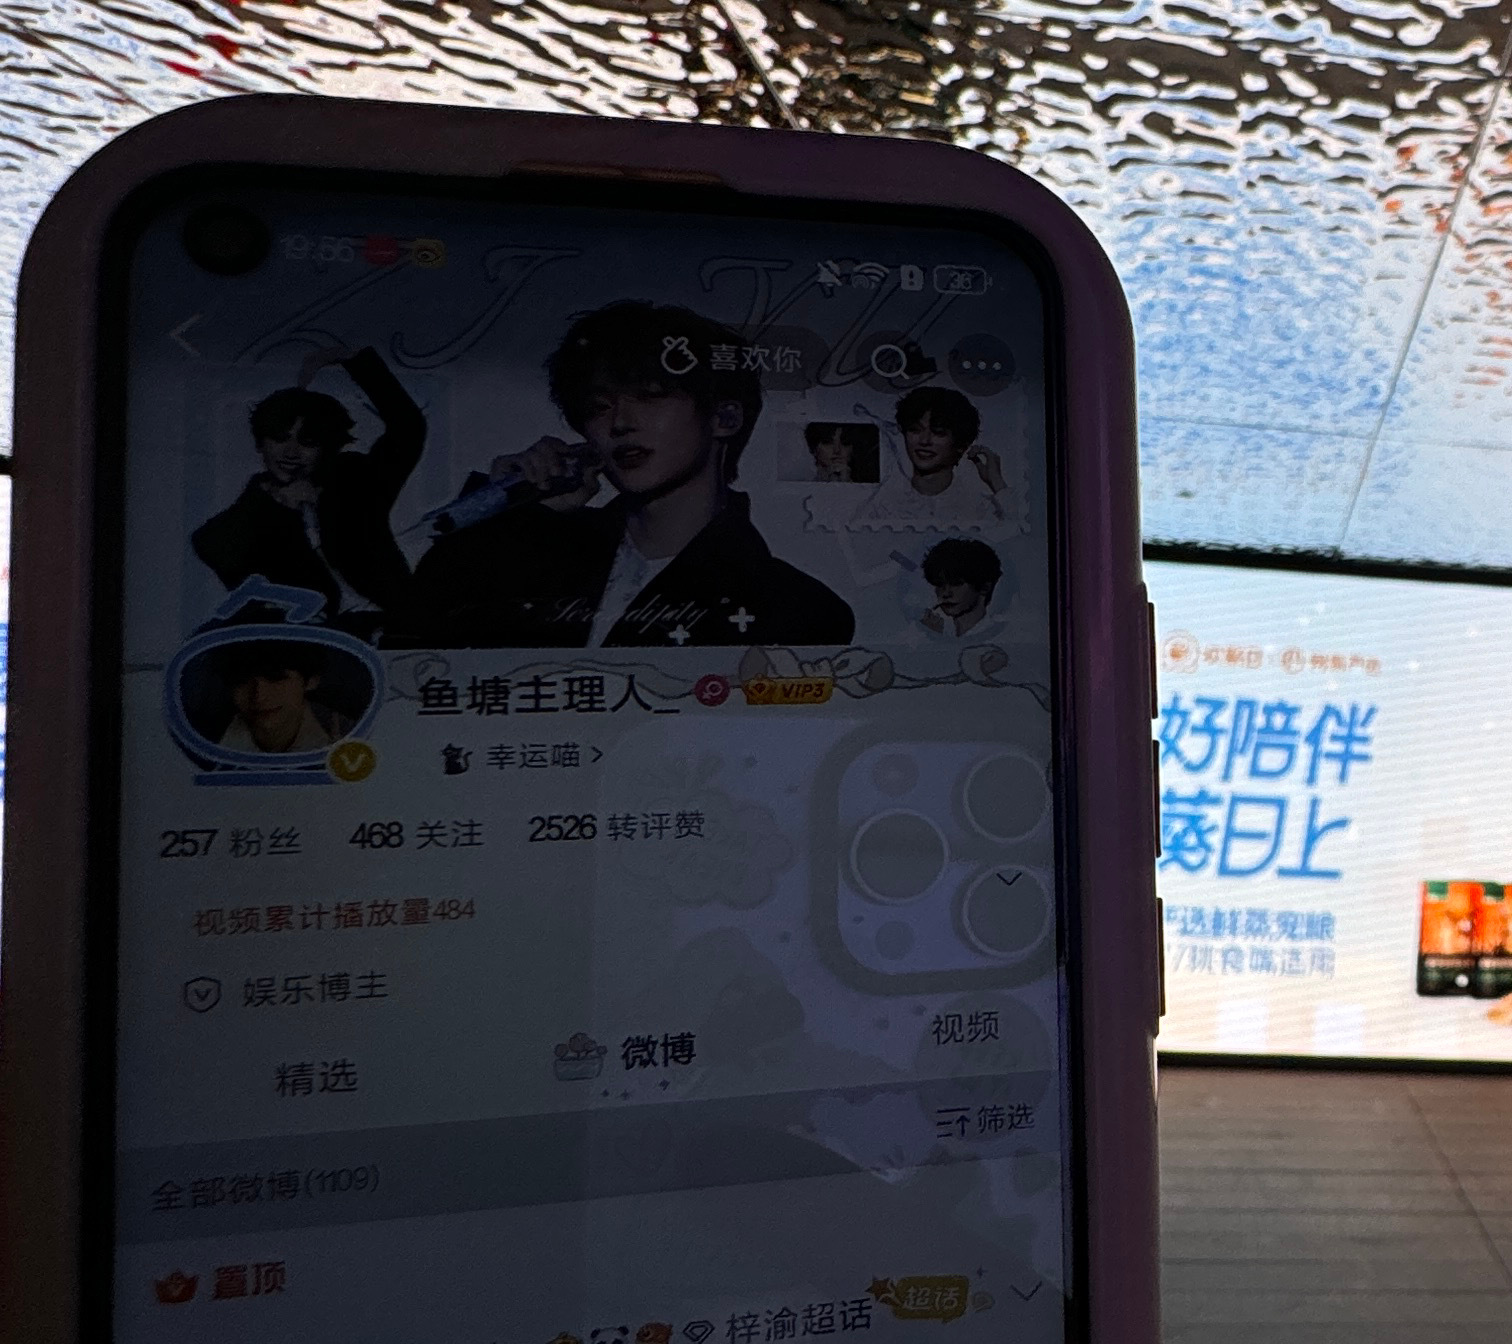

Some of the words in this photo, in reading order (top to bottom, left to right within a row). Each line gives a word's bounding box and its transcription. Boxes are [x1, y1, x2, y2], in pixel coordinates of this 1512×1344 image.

[708, 343, 802, 374] 喜欢你
[418, 674, 680, 716] 鱼塘主理人_
[781, 682, 826, 699] VIP3
[486, 742, 582, 771] 幸运喵
[1159, 691, 1380, 786] 好陪伴
[160, 829, 218, 858] 257
[229, 826, 302, 858] 粉丝
[349, 822, 405, 851] 468
[416, 818, 485, 850] 关注
[529, 814, 598, 843] 2526
[607, 810, 706, 841] 转评赞
[192, 897, 477, 939] 视频累计播放量484
[242, 971, 389, 1008] 娱乐博主
[274, 1061, 359, 1099] 精选
[621, 1032, 698, 1071] 微博
[931, 1011, 1001, 1048] 视频
[976, 1103, 1037, 1136] 筛选
[150, 1163, 381, 1212] 全部微博(1109)
[211, 1260, 288, 1301] 置顶
